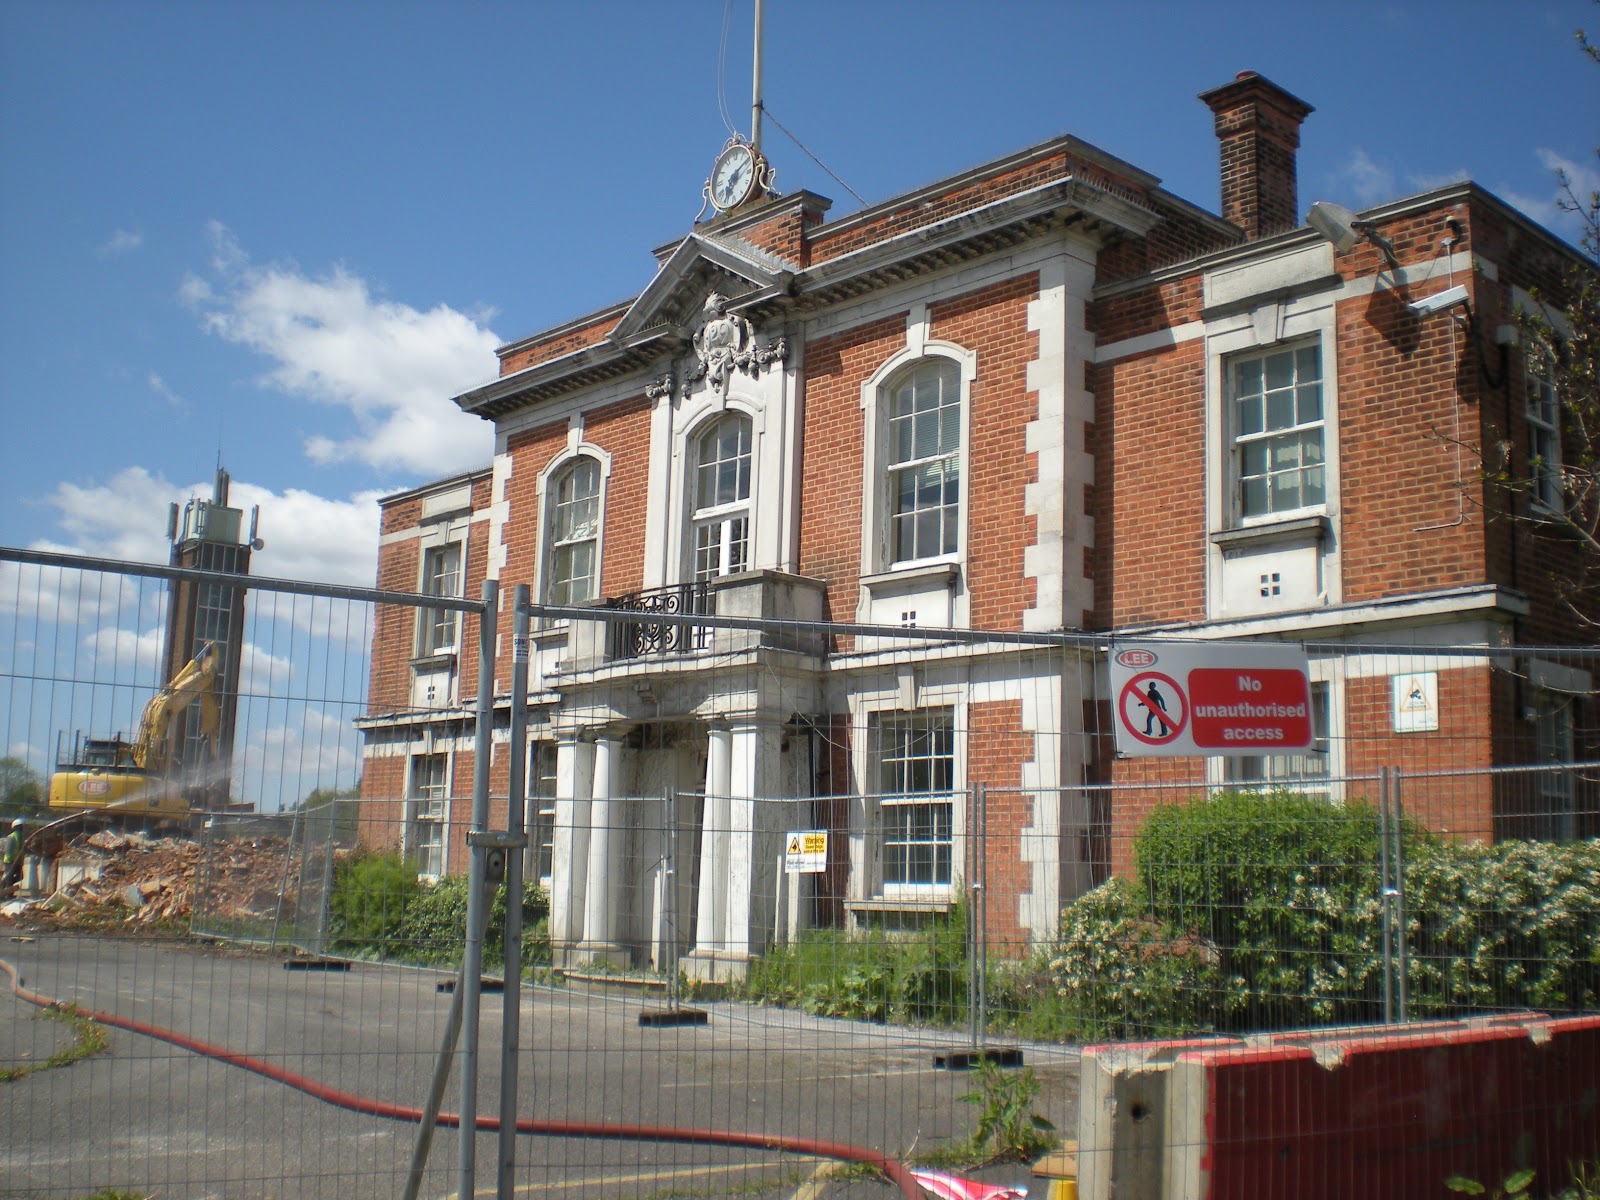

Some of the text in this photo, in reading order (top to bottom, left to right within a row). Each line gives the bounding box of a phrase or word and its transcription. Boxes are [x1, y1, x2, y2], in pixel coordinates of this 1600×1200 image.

[1124, 652, 1149, 665] LEE
[1238, 676, 1262, 692] No
[1195, 702, 1306, 718] unauthorised
[1223, 727, 1284, 740] access
